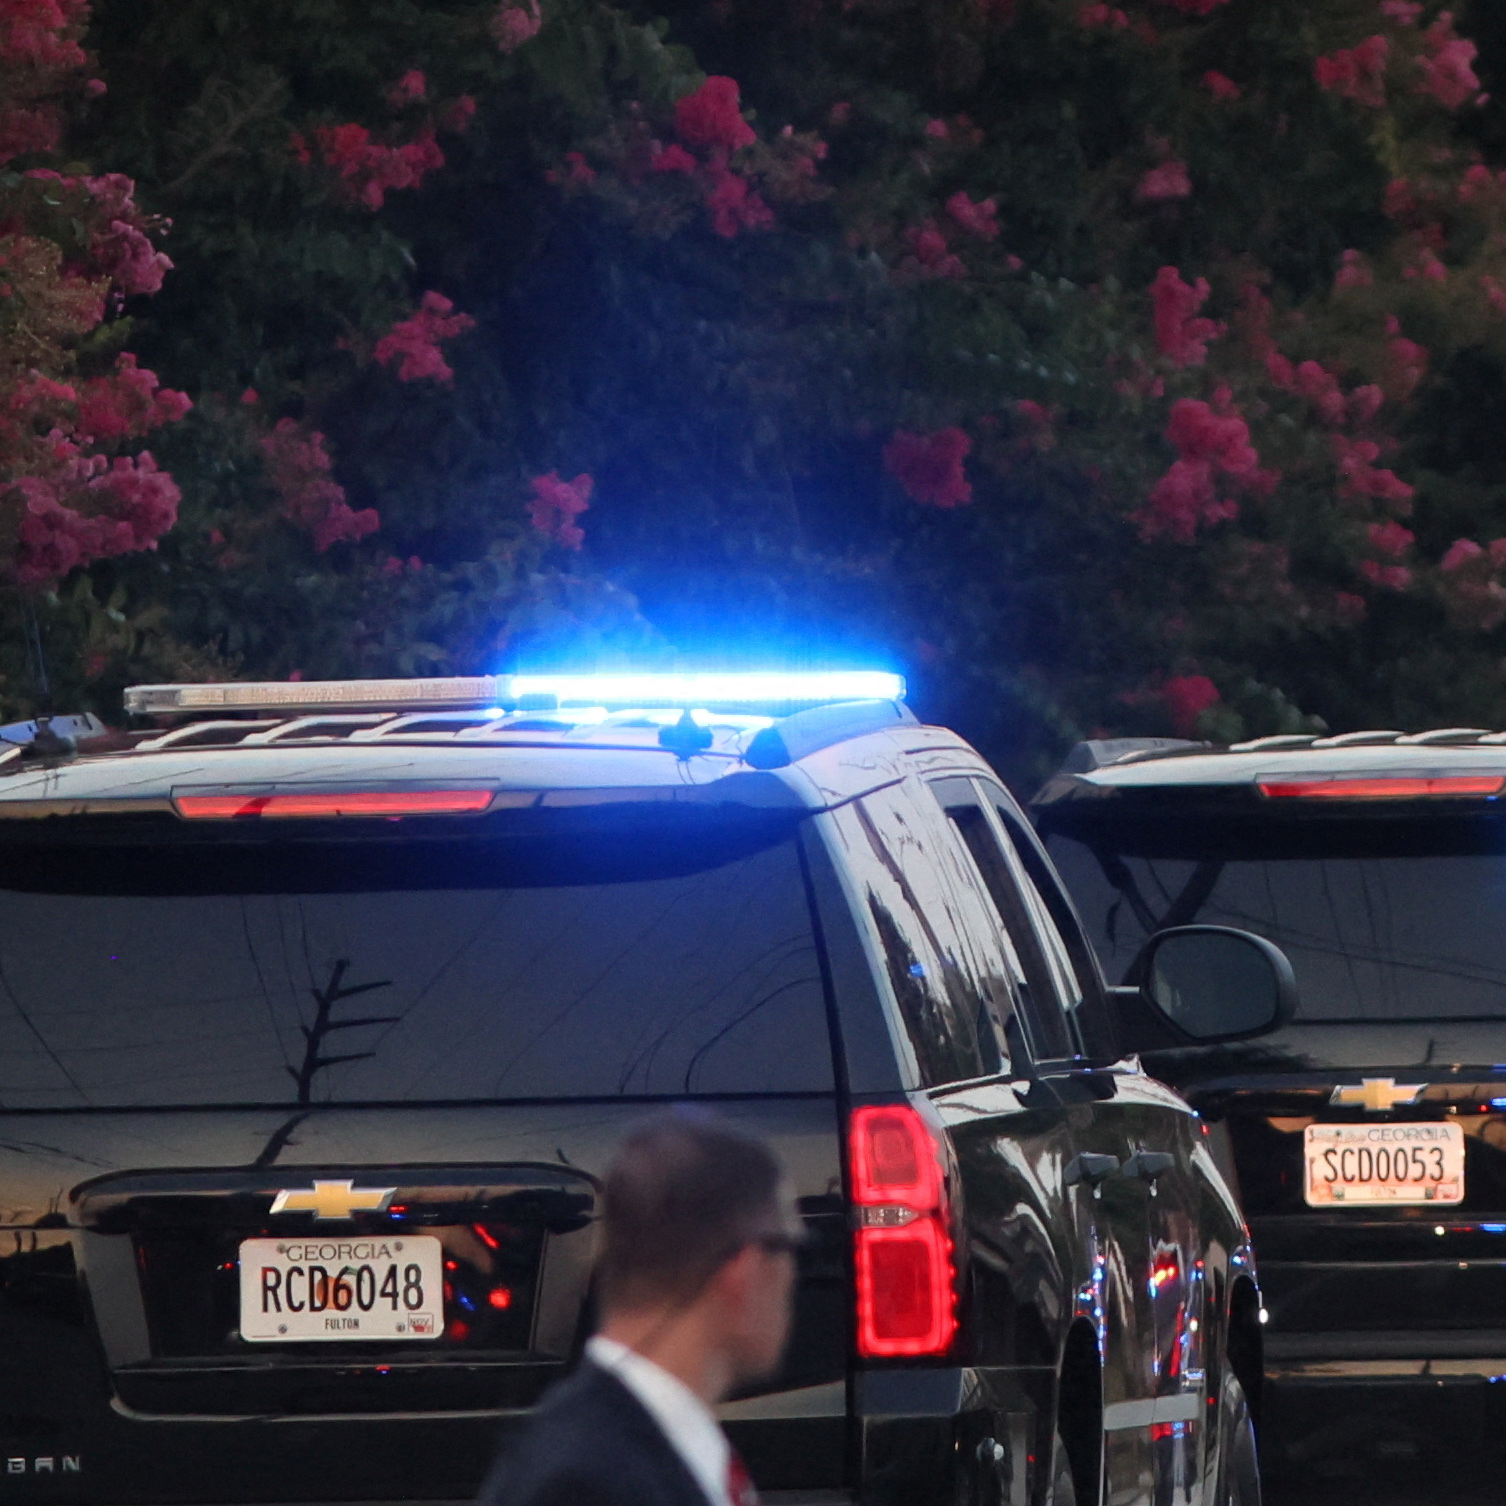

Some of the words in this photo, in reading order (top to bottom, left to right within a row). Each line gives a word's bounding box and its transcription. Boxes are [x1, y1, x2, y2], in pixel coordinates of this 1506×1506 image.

[1367, 1127, 1451, 1143] GEORGIA
[1323, 1147, 1444, 1182] SCD0053
[286, 1243, 393, 1262] GEORGIA
[261, 1263, 424, 1313] RCD6048
[324, 1317, 360, 1331] FULTON
